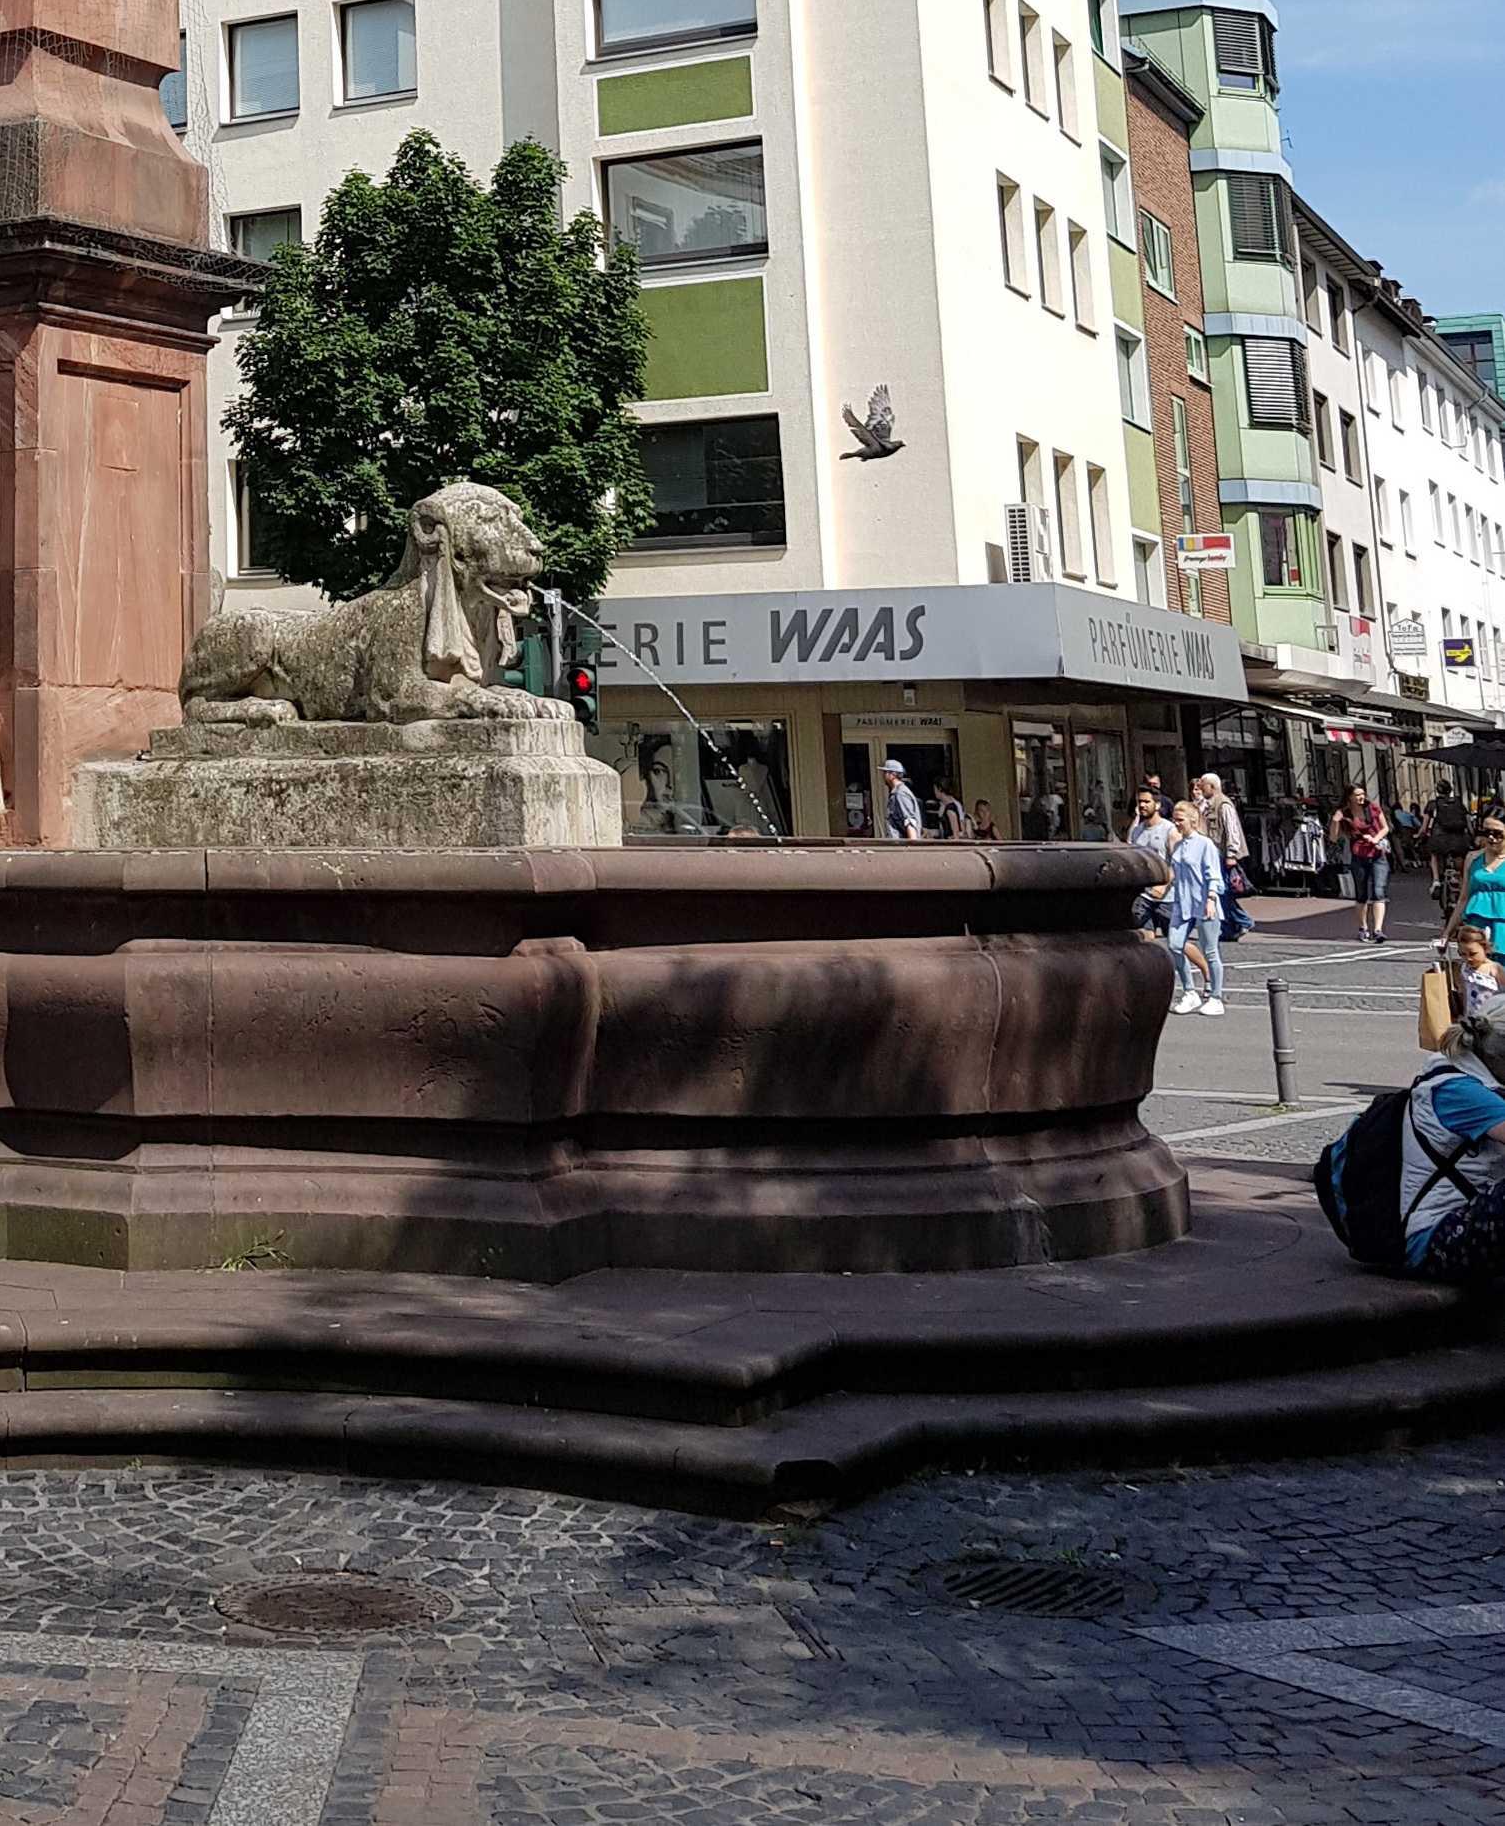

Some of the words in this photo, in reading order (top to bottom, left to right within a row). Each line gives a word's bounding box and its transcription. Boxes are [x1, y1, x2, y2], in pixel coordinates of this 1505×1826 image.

[770, 604, 926, 664] WAAS
[1088, 612, 1182, 675] PARFÜMERIE
[1181, 629, 1215, 680] WAAS
